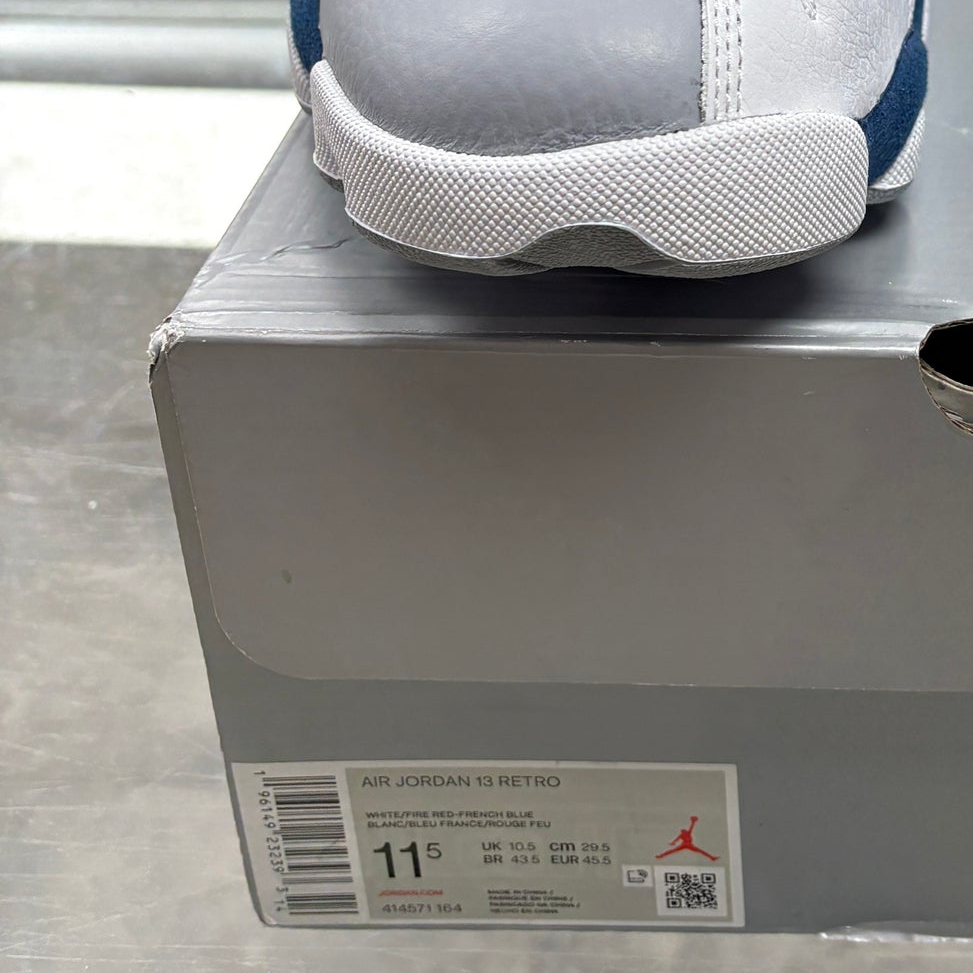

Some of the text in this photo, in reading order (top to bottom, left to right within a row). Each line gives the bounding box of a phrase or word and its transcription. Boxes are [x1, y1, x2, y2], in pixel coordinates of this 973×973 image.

[362, 775, 561, 787] AIR JORDAN 13 RETRO
[506, 811, 534, 819] BLUE
[530, 820, 551, 828] FEU
[481, 842, 611, 852] UK 10.5 cm 29.5
[483, 854, 503, 864] BR
[550, 855, 579, 865] EUR
[582, 855, 612, 865] 45.5
